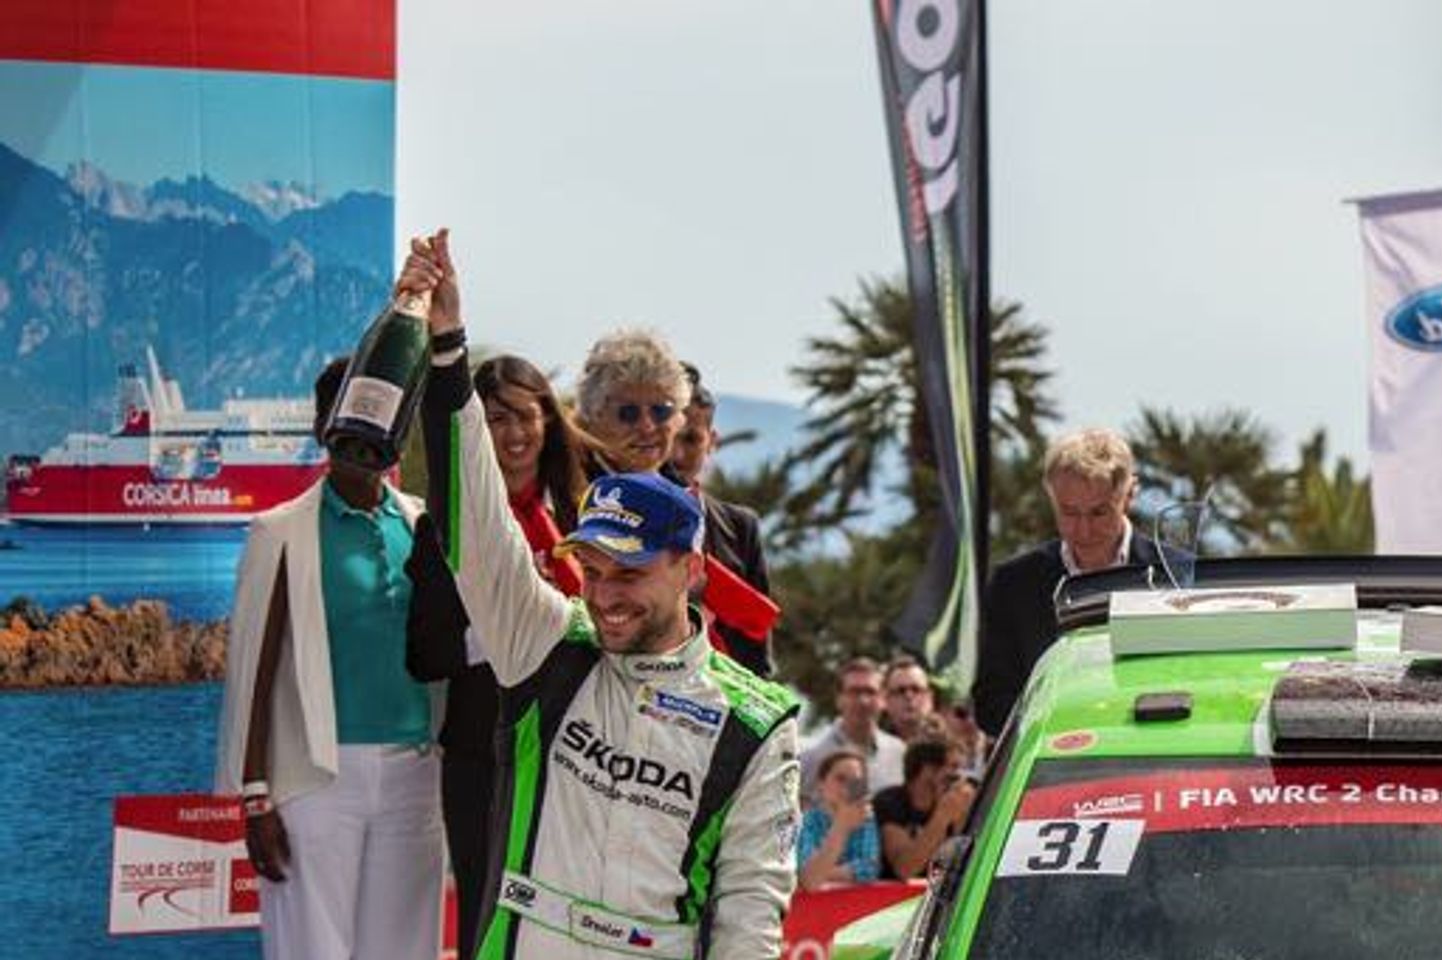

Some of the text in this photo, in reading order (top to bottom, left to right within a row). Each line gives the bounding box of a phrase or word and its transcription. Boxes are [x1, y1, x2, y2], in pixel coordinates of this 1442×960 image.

[123, 482, 190, 505] CORSICA
[562, 719, 695, 800] ŠKODA
[1179, 788, 1237, 809] FIA
[1250, 785, 1334, 804] WRC
[1341, 785, 1361, 801] 2
[1027, 821, 1110, 871] 31
[158, 862, 173, 876] DE
